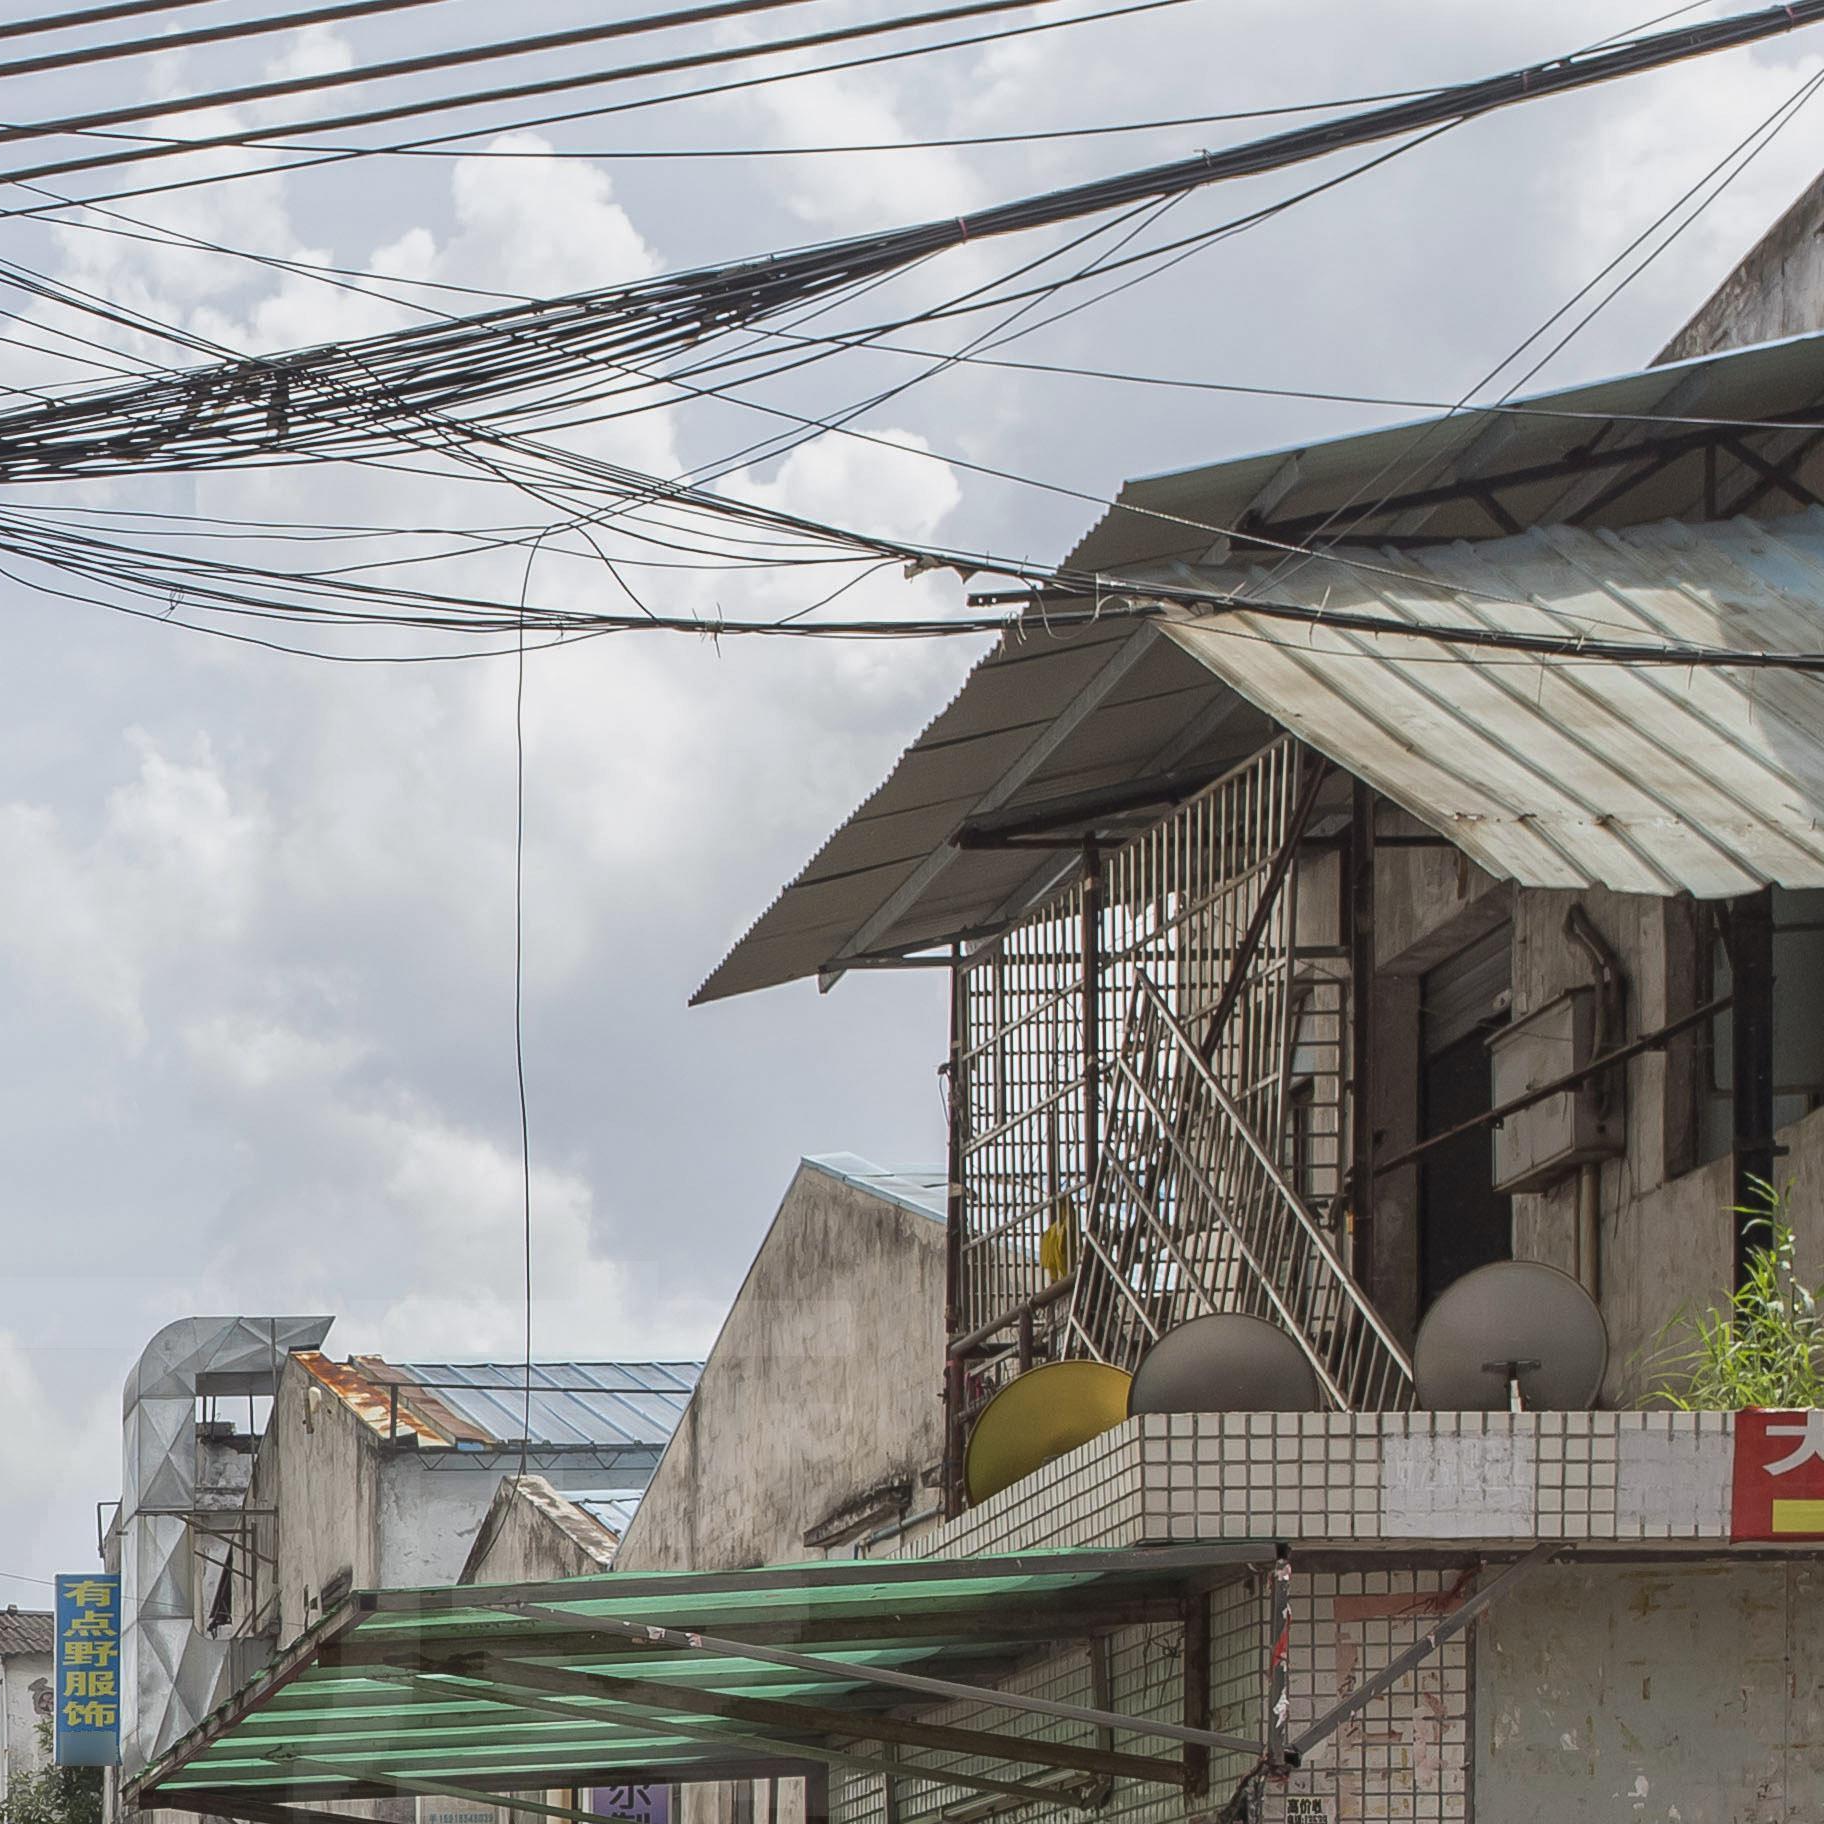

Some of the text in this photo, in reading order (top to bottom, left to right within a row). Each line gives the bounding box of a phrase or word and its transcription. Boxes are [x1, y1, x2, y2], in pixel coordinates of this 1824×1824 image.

[62, 1580, 118, 1728] 有点野服饰
